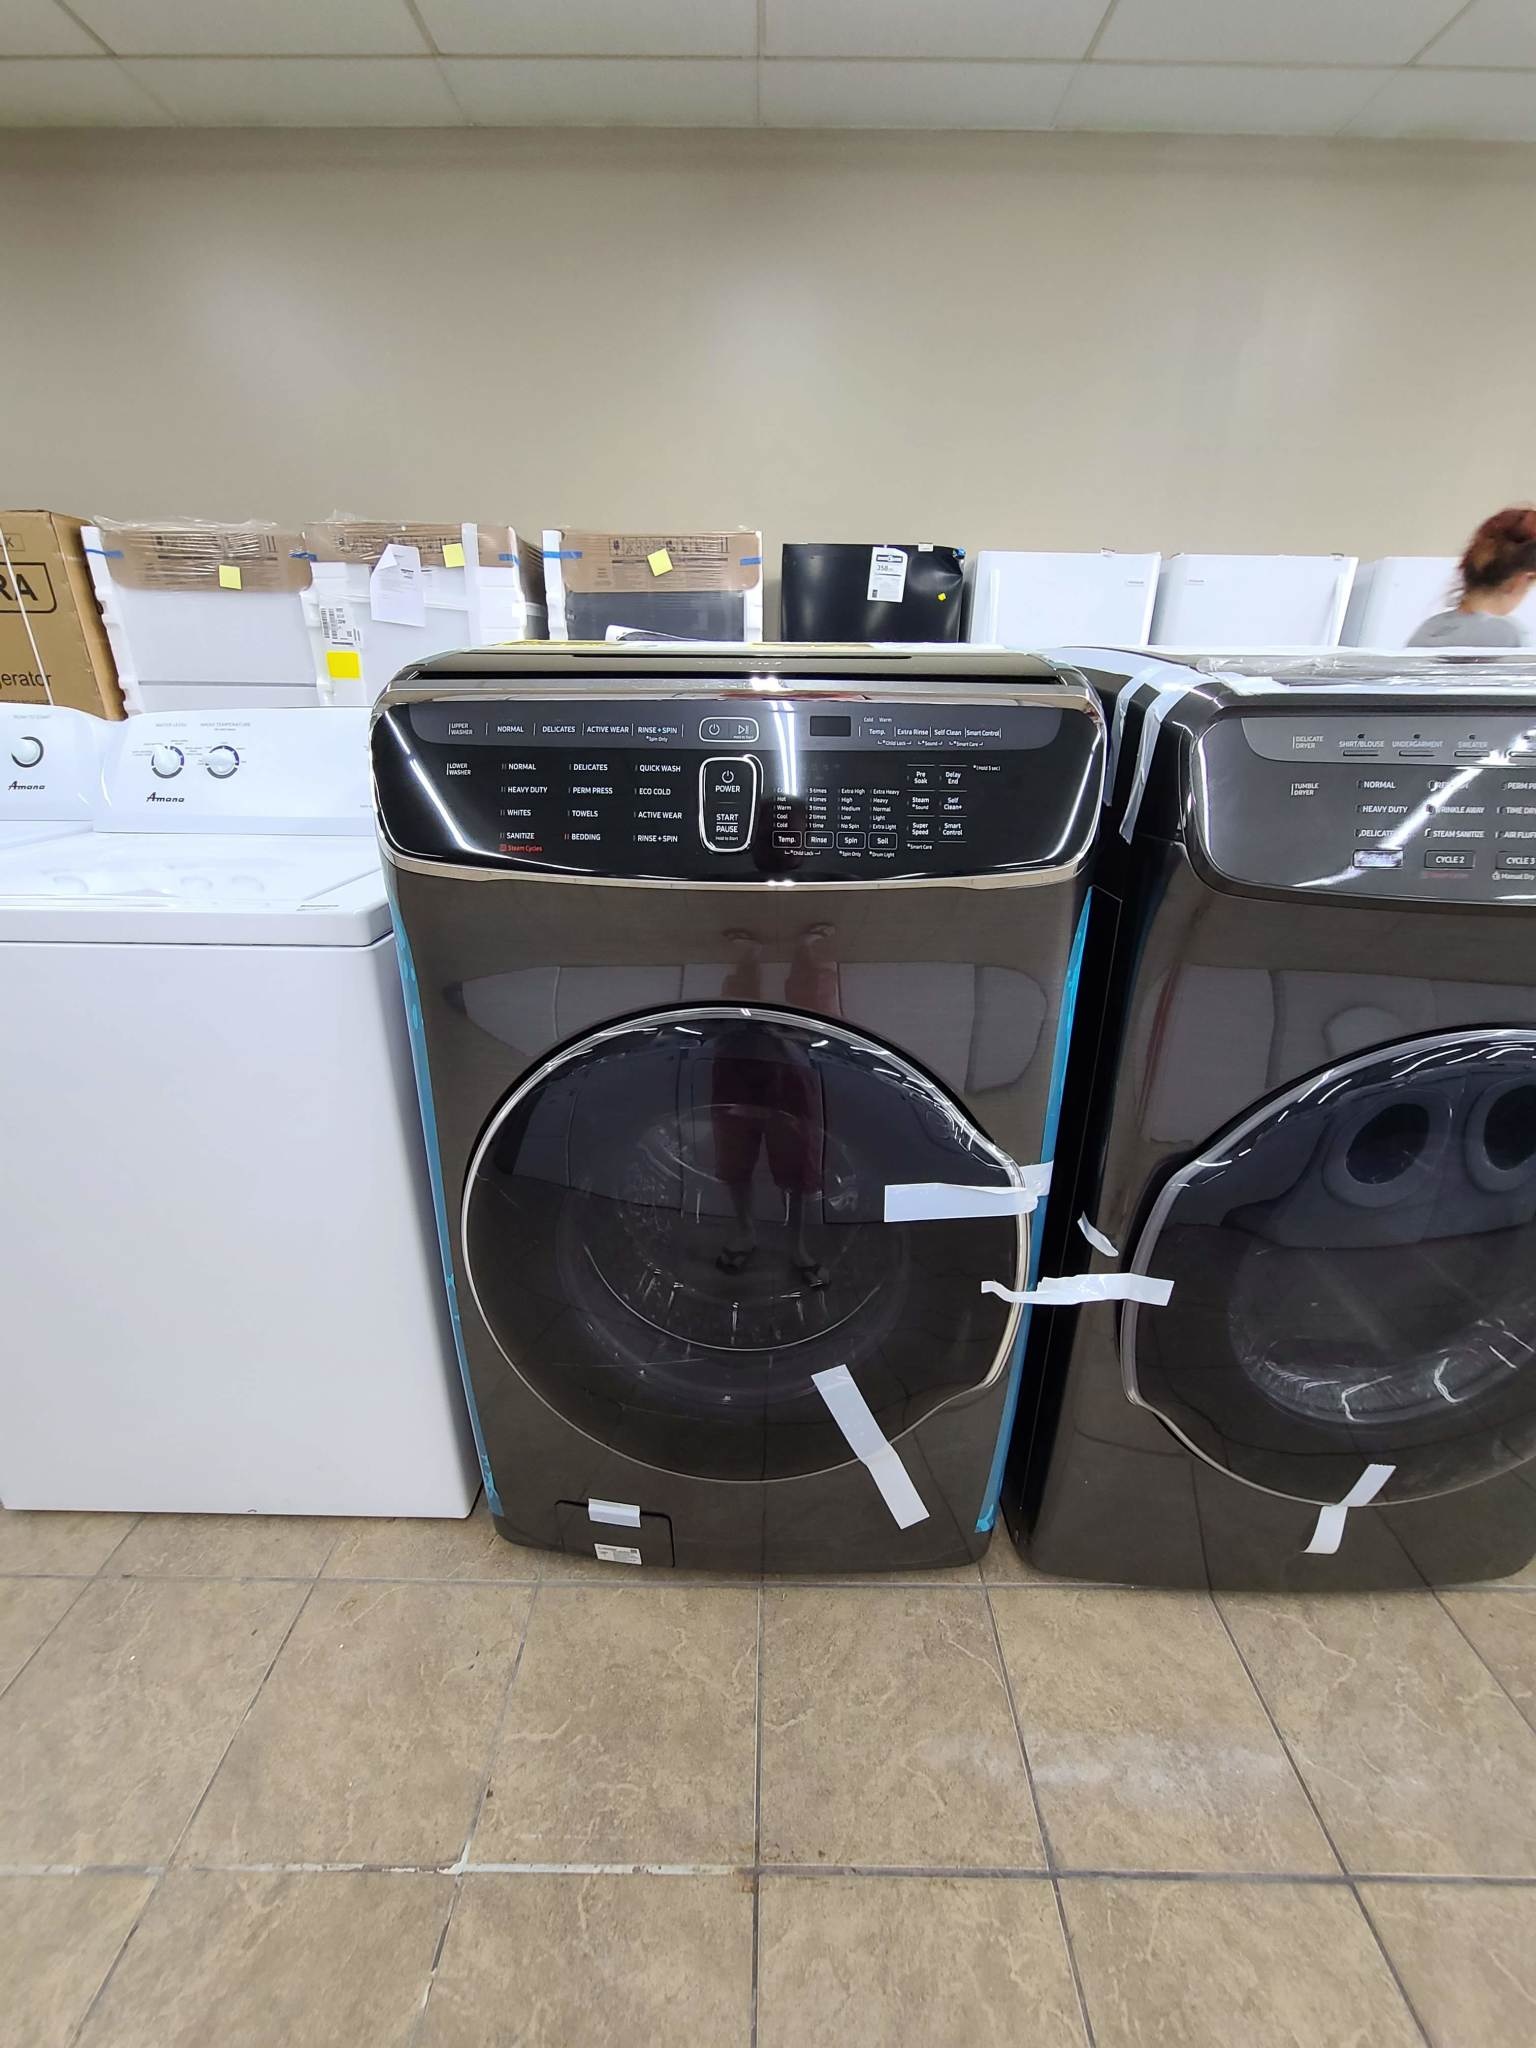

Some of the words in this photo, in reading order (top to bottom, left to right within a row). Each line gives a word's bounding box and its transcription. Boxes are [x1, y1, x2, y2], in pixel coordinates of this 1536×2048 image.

[0, 671, 52, 689] erator
[8, 780, 46, 791] Amana
[1508, 782, 1528, 790] PERM
[146, 792, 185, 803] Amana
[1436, 856, 1459, 864] CYCLE
[1460, 856, 1465, 864] 2
[1506, 857, 1528, 865] CYCLE
[1530, 857, 1536, 865] 3
